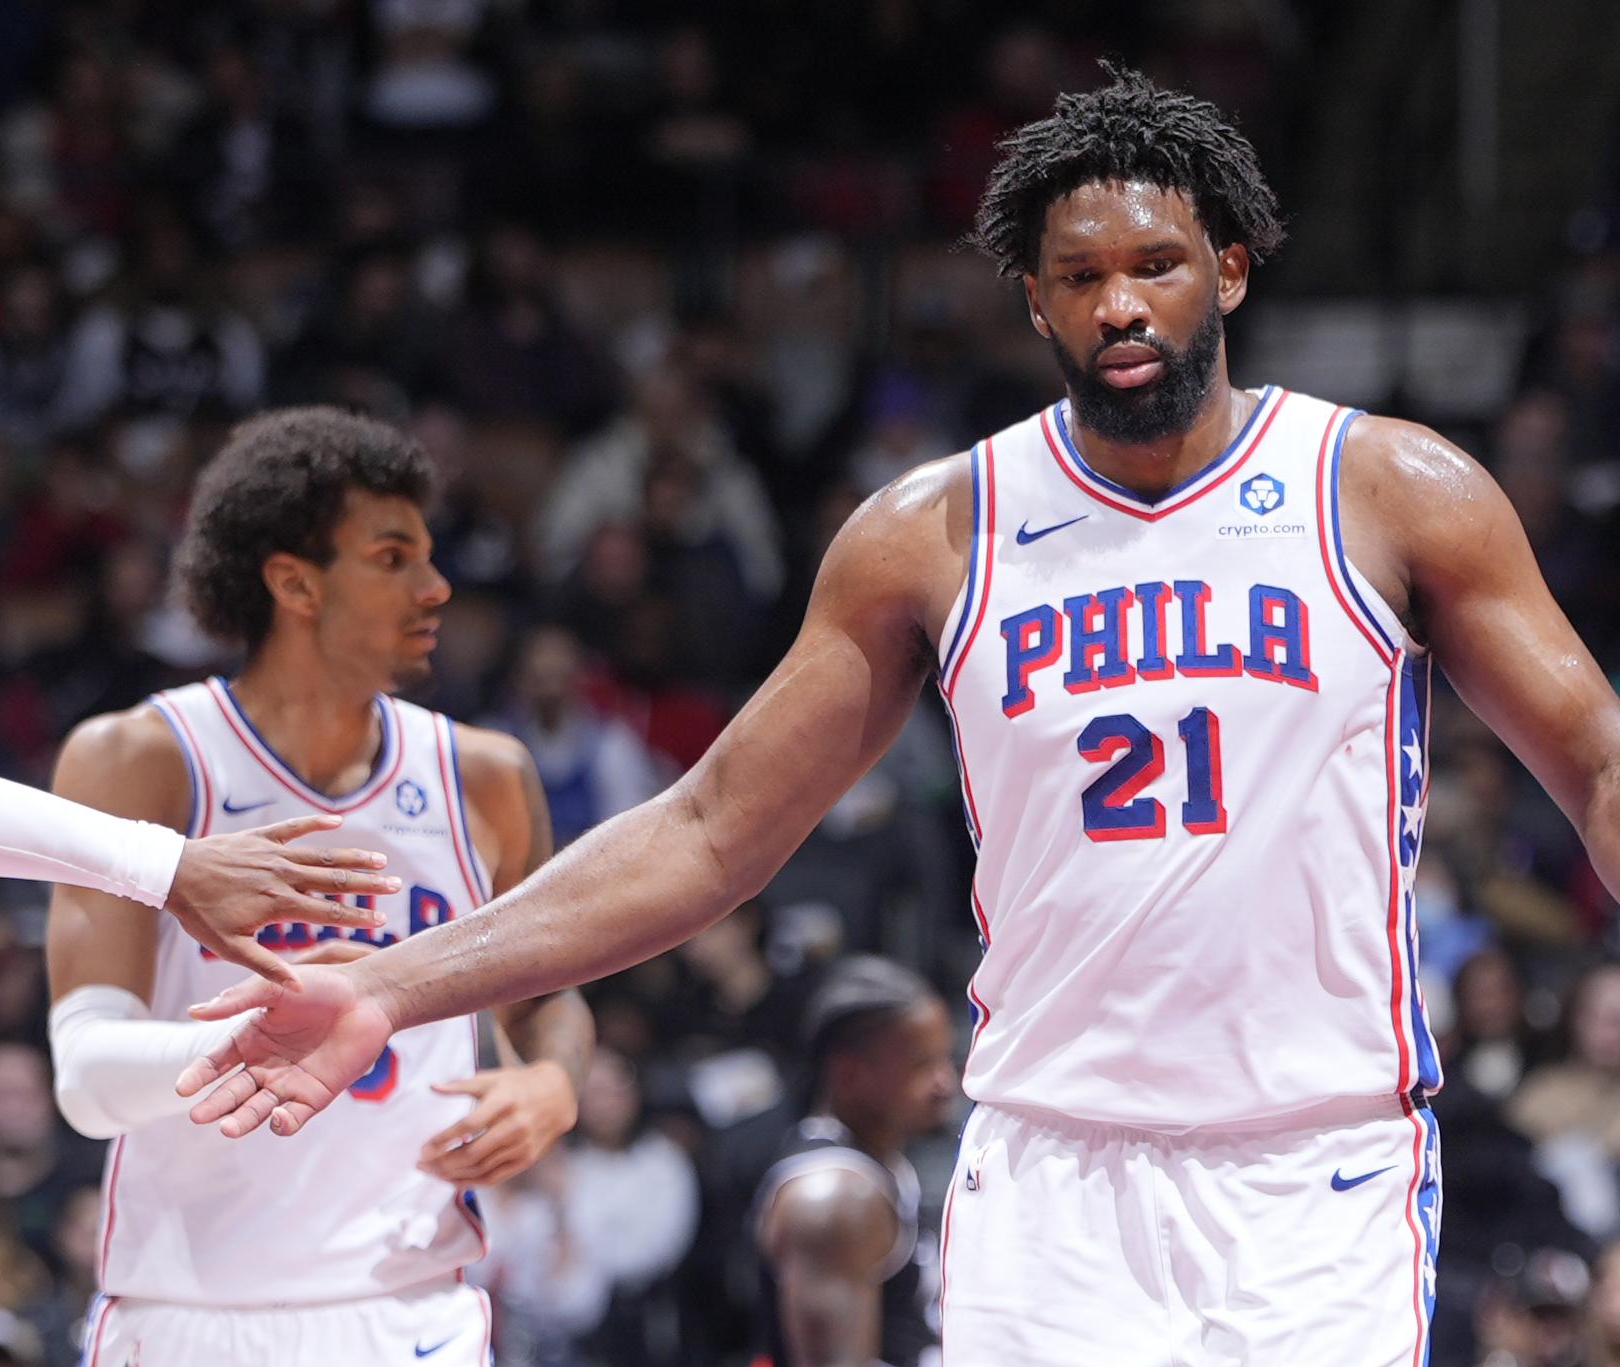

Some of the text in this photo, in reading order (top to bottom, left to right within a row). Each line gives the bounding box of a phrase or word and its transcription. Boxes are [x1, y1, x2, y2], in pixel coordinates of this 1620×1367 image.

[1217, 523, 1306, 538] crypto.com
[1000, 580, 1319, 718] PHILA
[1077, 706, 1227, 843] 21
